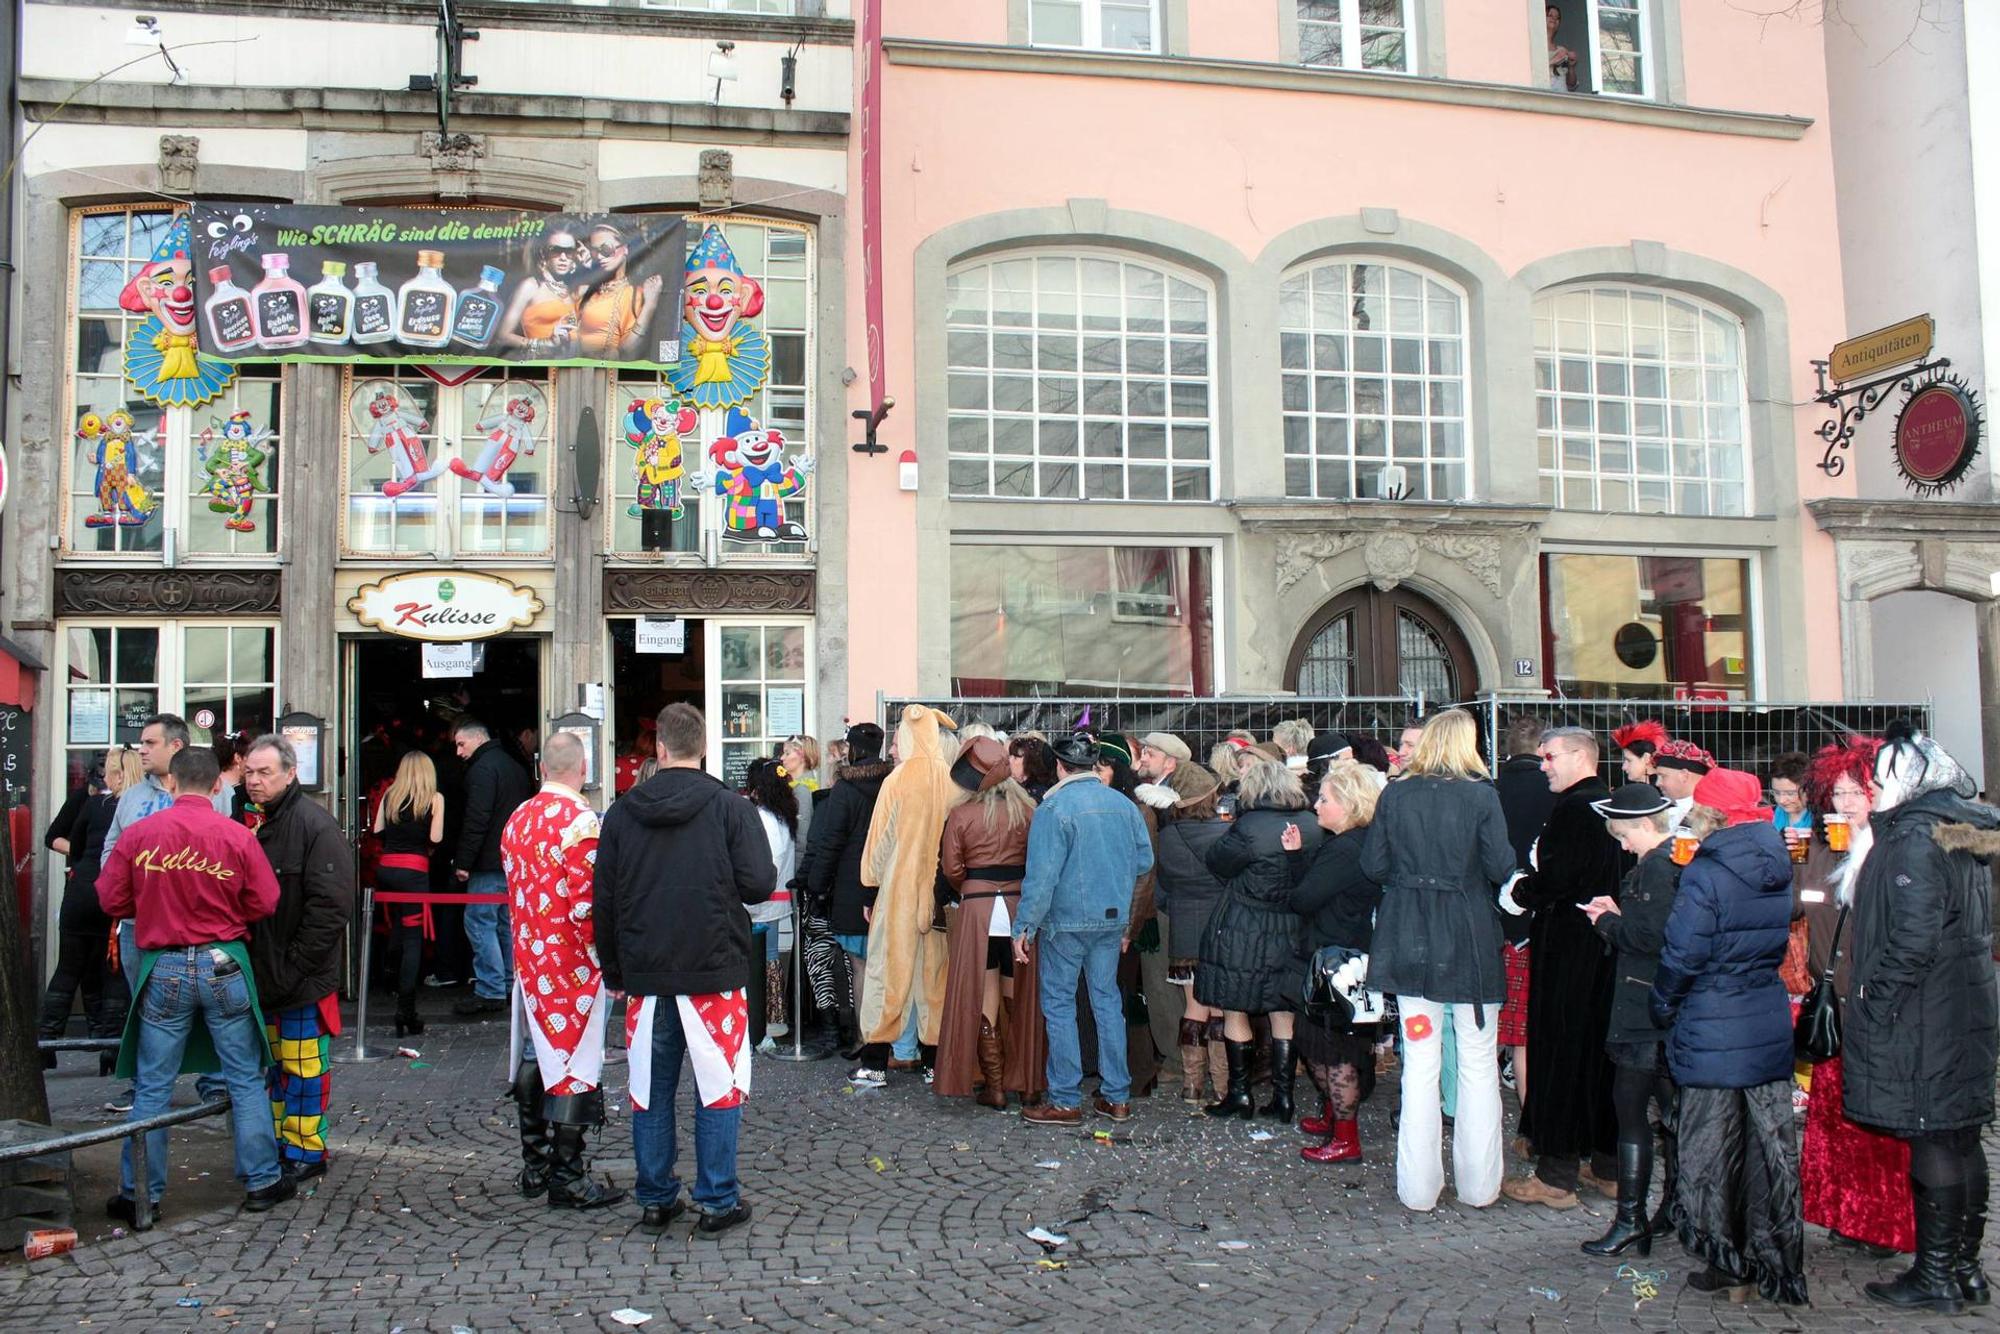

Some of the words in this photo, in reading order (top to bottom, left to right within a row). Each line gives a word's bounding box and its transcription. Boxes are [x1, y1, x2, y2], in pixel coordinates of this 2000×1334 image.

[277, 229, 308, 247] Wie
[309, 219, 397, 246] SCHRÄG
[399, 225, 437, 242] sind
[438, 221, 470, 241] die
[472, 219, 545, 240] denn!?!?
[1841, 332, 1921, 368] Antiquitäten
[394, 602, 497, 628] Kulisse
[638, 633, 684, 648] Eingang
[425, 658, 473, 671] Ausgang
[1518, 659, 1531, 674] 12
[132, 705, 146, 713] WC
[125, 713, 139, 721] Nur
[127, 720, 146, 728] Gäst
[135, 845, 235, 881] Kulisse
